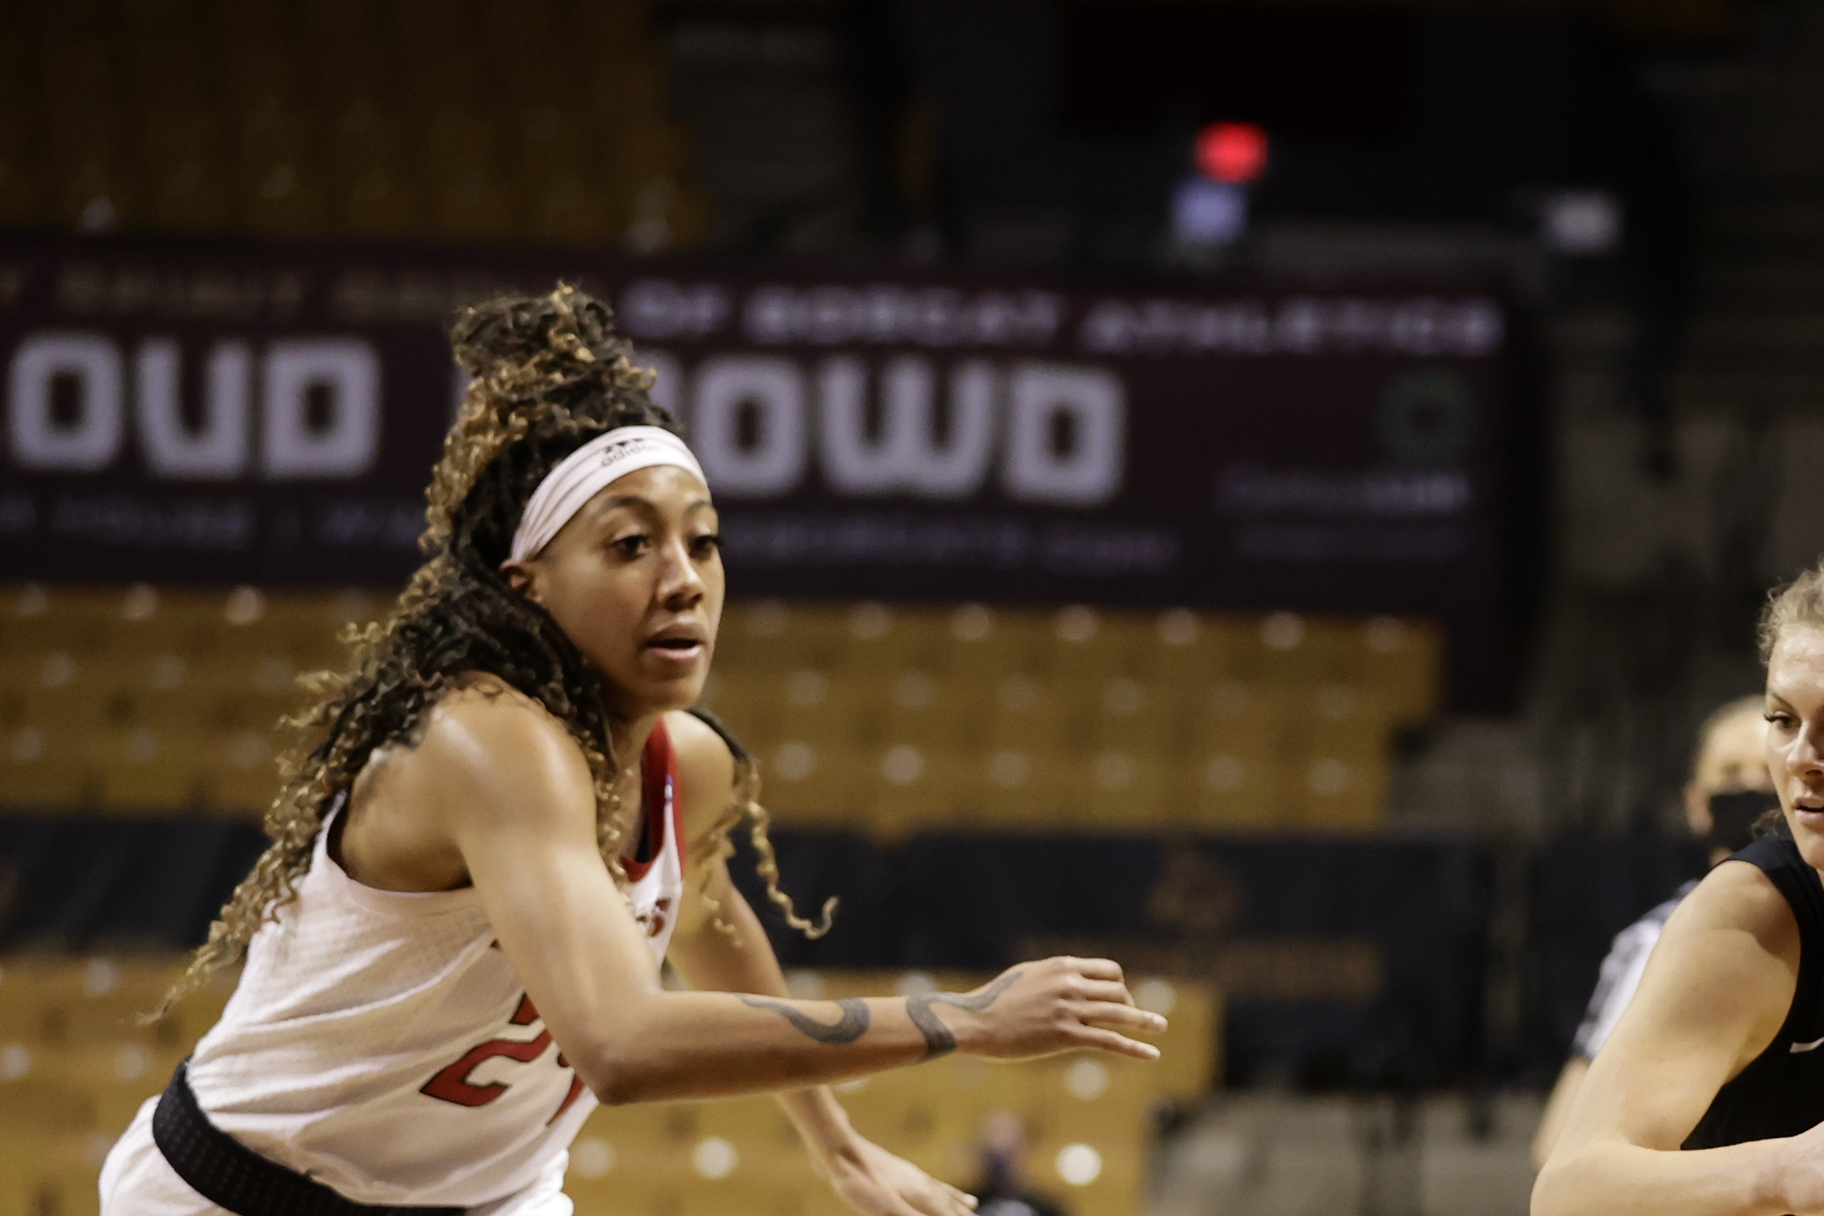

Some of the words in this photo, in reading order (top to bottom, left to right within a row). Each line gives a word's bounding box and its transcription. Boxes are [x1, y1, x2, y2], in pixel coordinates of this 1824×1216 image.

[741, 283, 1068, 348] BOBCAT
[1076, 294, 1507, 357] ATHLETICS
[419, 992, 588, 1127] 2
